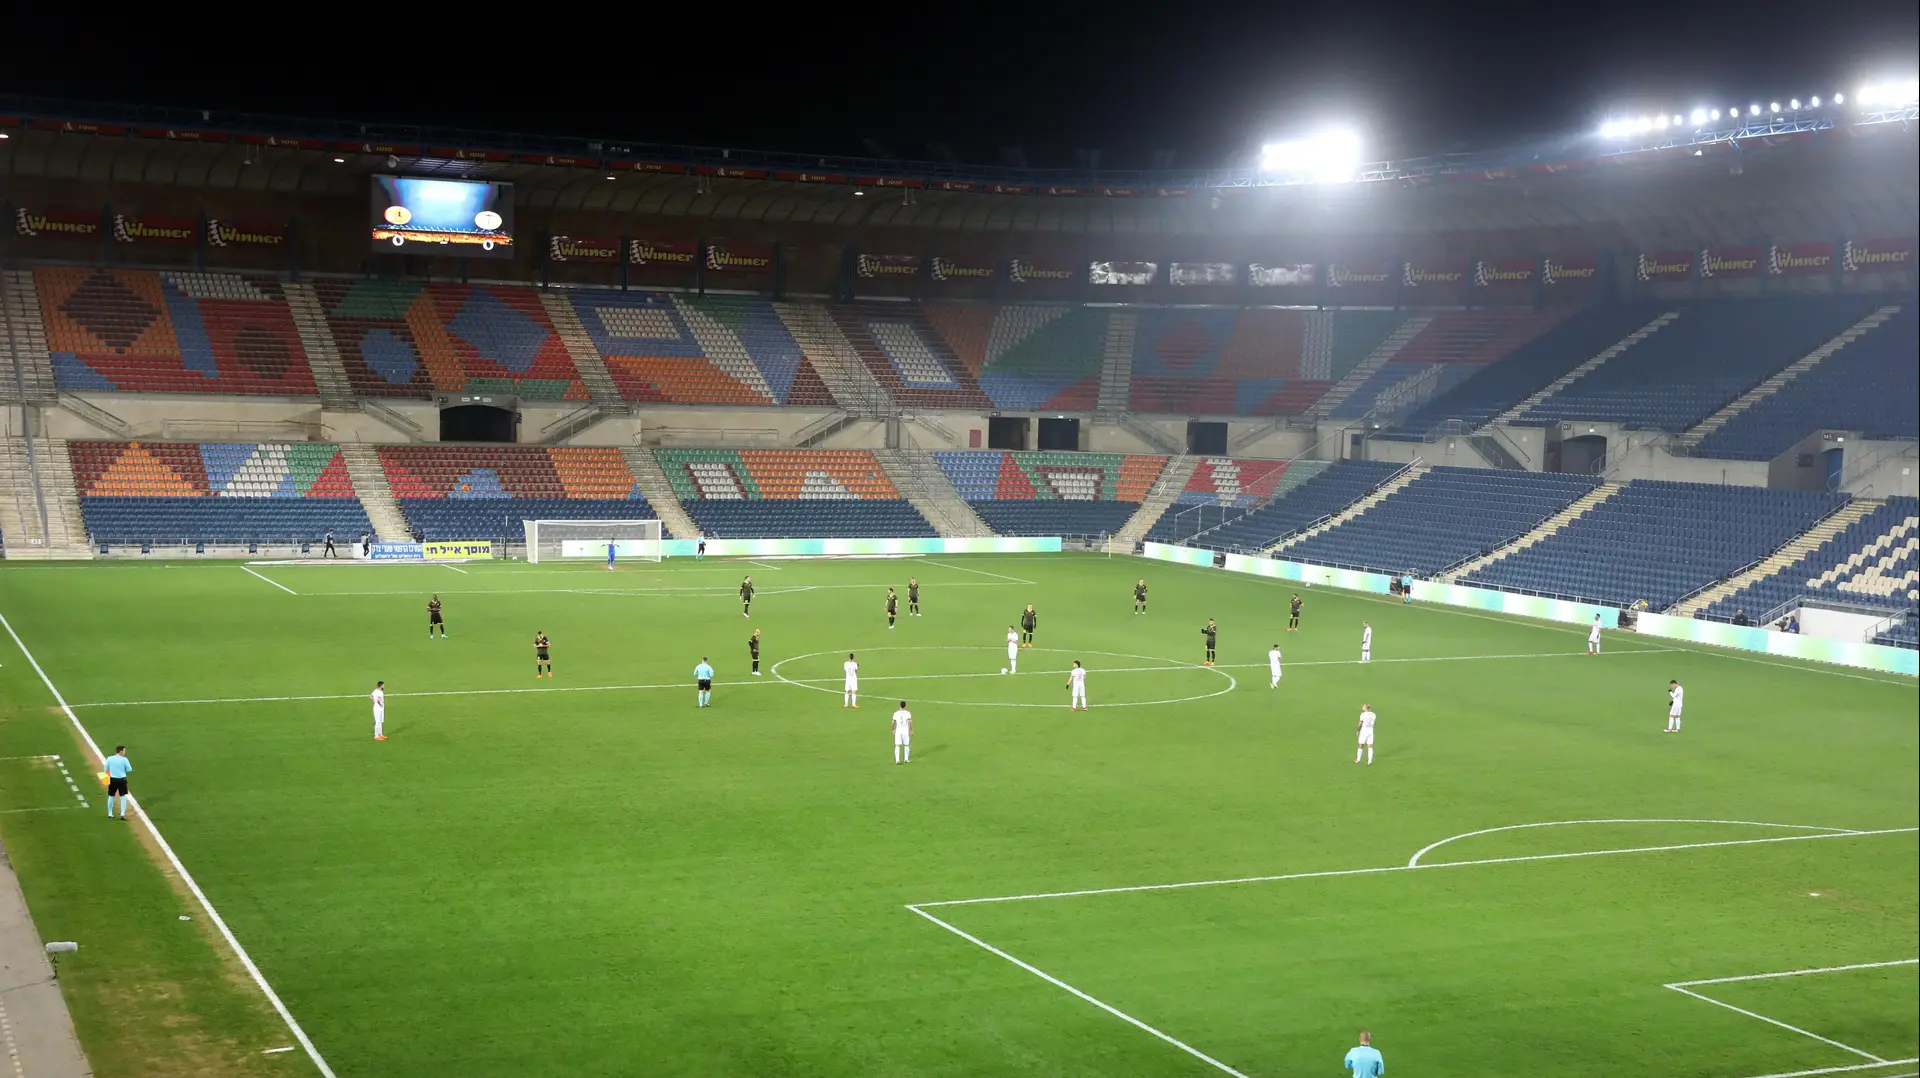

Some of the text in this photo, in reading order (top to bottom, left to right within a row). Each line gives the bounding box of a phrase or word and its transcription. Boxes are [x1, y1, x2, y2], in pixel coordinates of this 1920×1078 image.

[27, 214, 97, 234] Winner
[123, 220, 192, 239] Winner
[218, 227, 284, 245] Winner
[392, 234, 404, 247] 0
[482, 239, 494, 251] 0
[440, 545, 461, 554] אייל
[464, 546, 490, 555] מוסך
